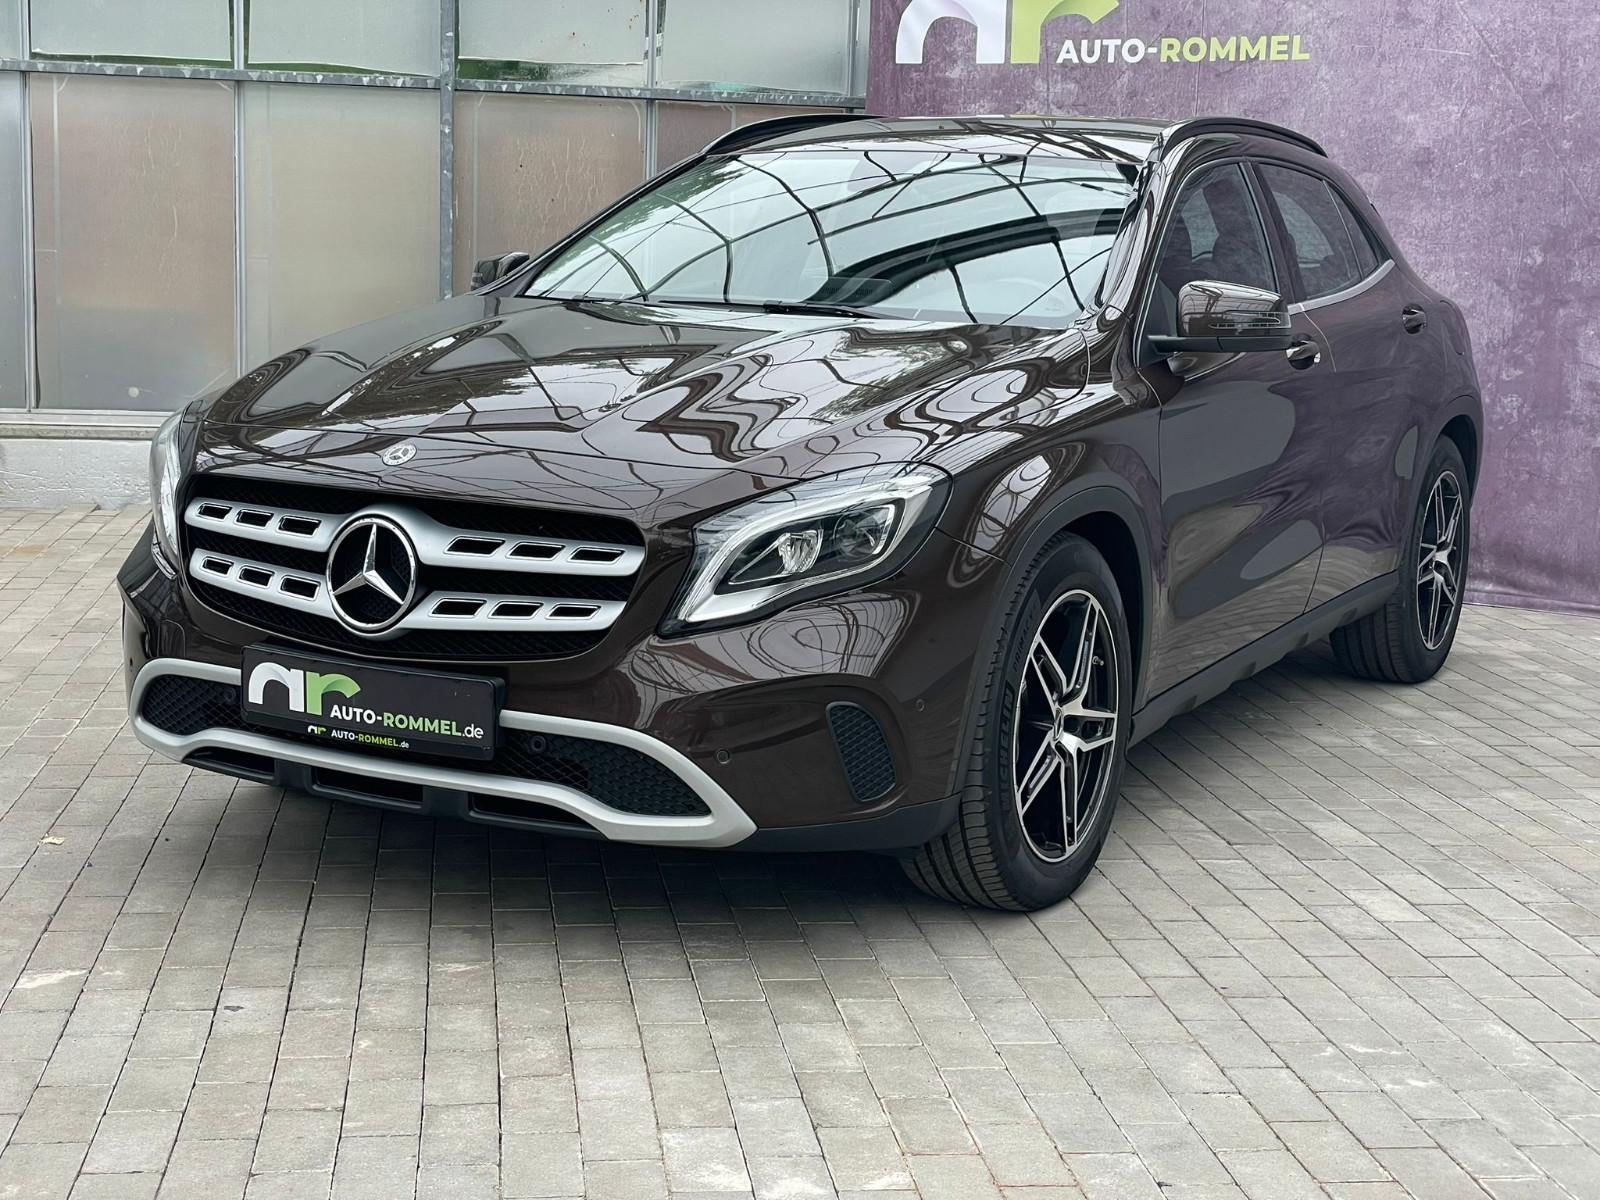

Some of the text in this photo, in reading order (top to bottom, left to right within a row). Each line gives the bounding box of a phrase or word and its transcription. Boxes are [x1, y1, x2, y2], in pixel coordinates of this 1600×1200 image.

[1057, 35, 1311, 64] AUTO-ROMMEL
[330, 705, 484, 739] AUTO-ROMMEL.de
[331, 729, 410, 749] AUTO-ROMMEL.de
[999, 687, 1014, 812] MICHELIN
